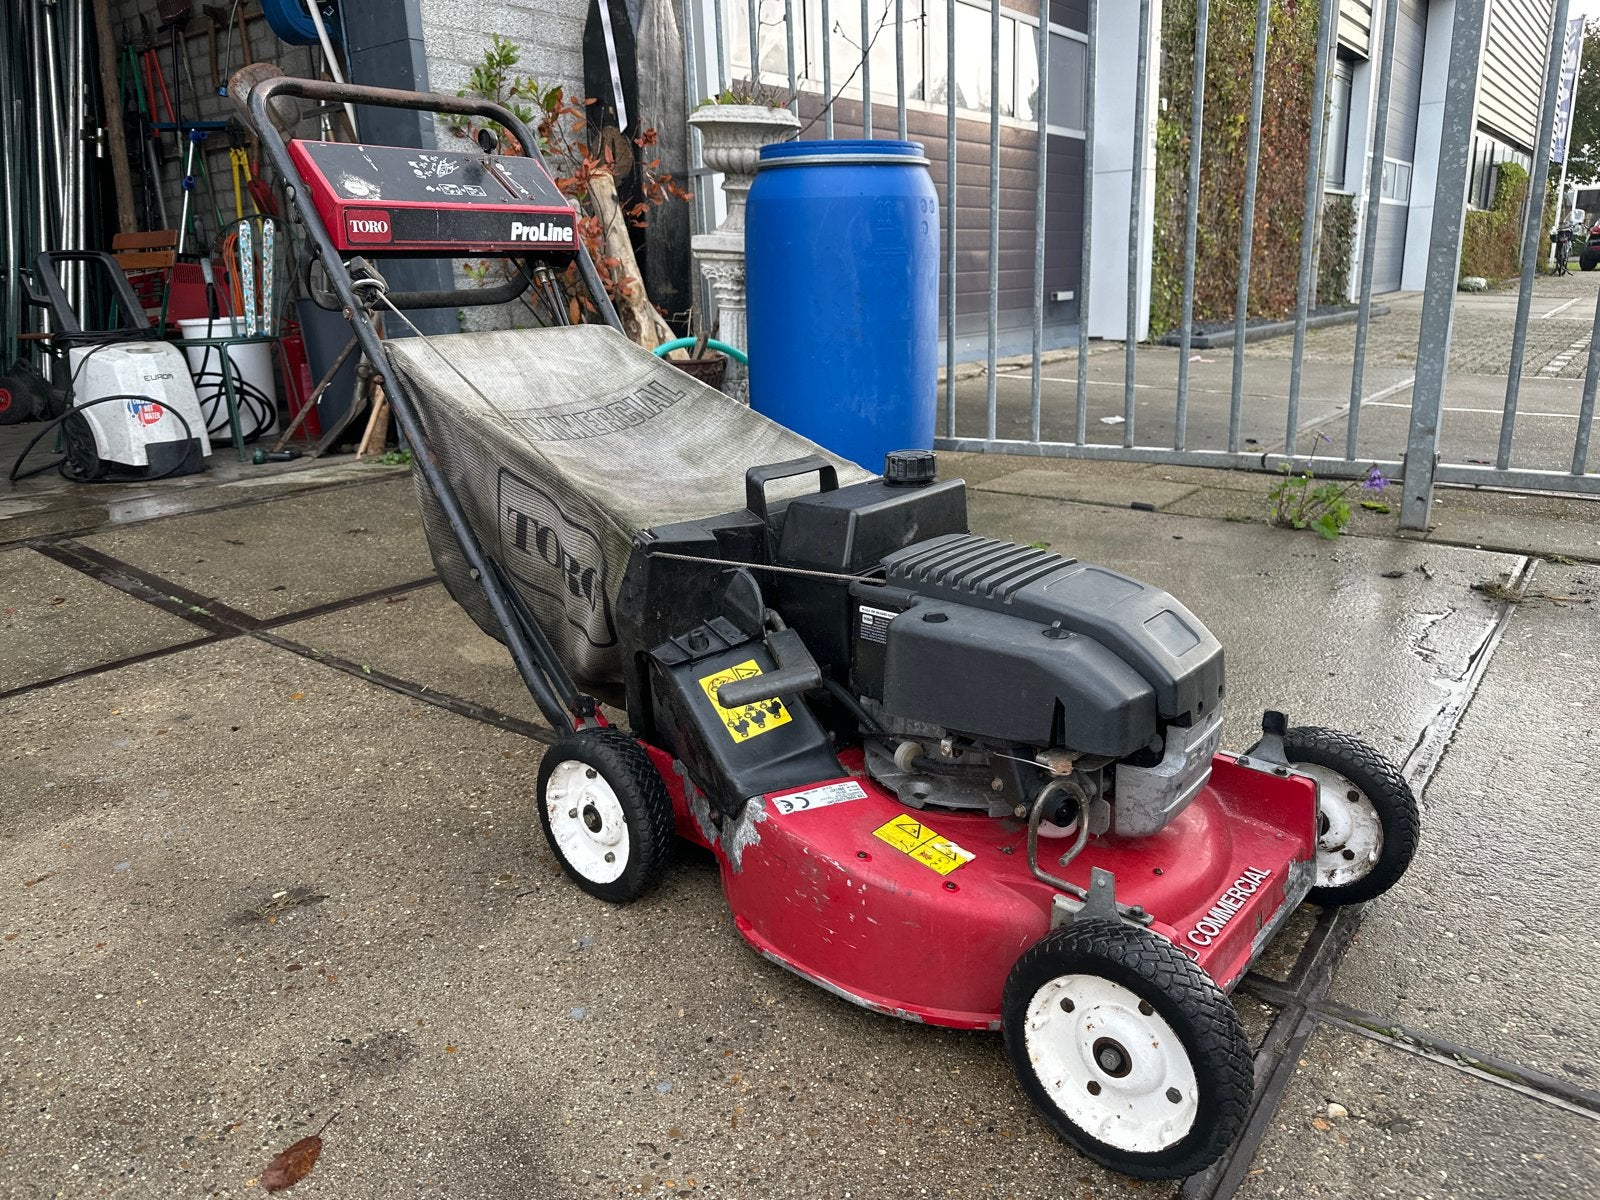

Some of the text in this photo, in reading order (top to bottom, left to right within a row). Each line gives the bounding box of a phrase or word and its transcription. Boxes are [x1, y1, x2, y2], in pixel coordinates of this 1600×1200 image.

[350, 219, 573, 242] TORO ProLine
[1186, 866, 1272, 947] COMMERCIAL
